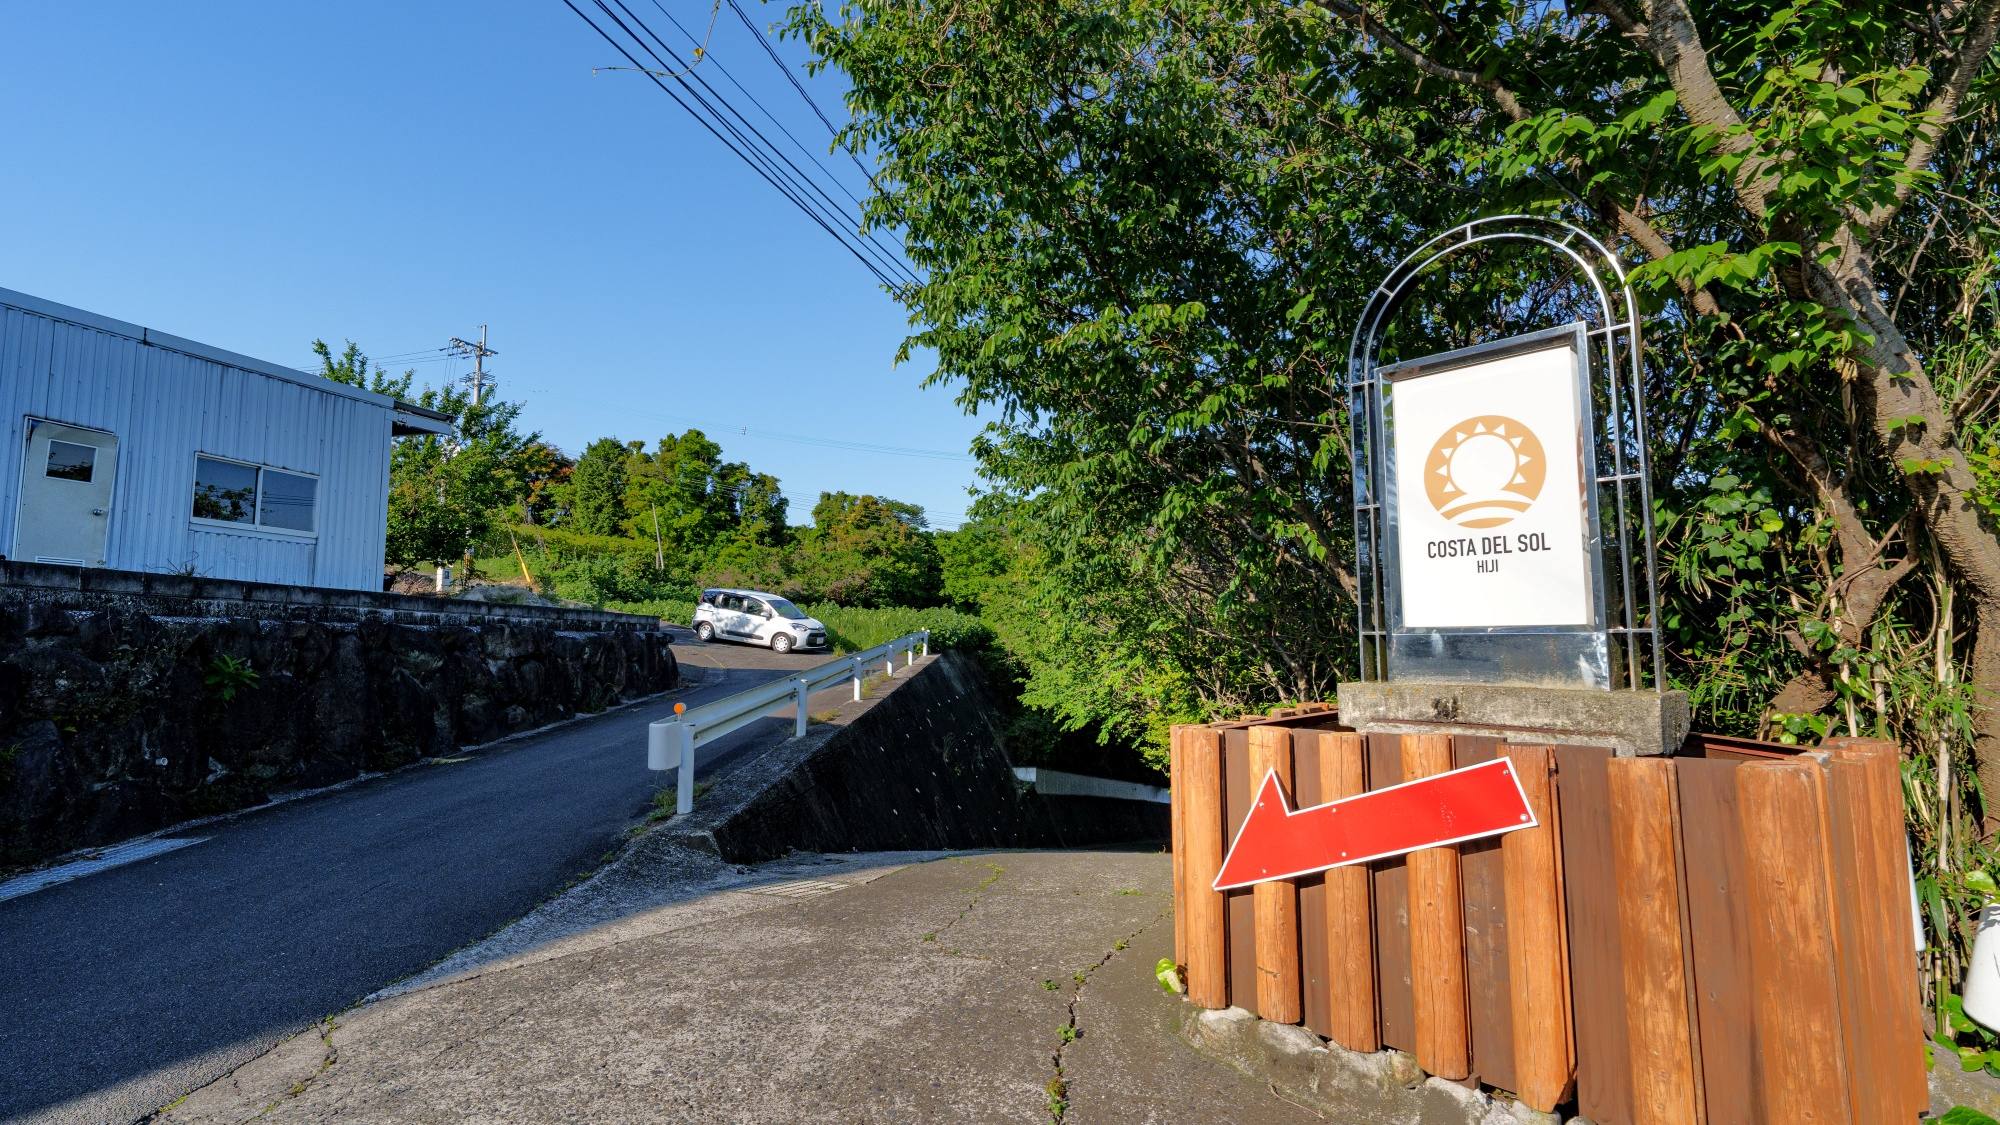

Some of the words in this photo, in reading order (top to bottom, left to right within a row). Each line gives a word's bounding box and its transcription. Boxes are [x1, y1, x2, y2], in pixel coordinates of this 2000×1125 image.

[1427, 538, 1477, 558] COSTA
[1482, 536, 1513, 555] DEL
[1517, 532, 1551, 553] SOL
[1477, 559, 1499, 574] HIJI
